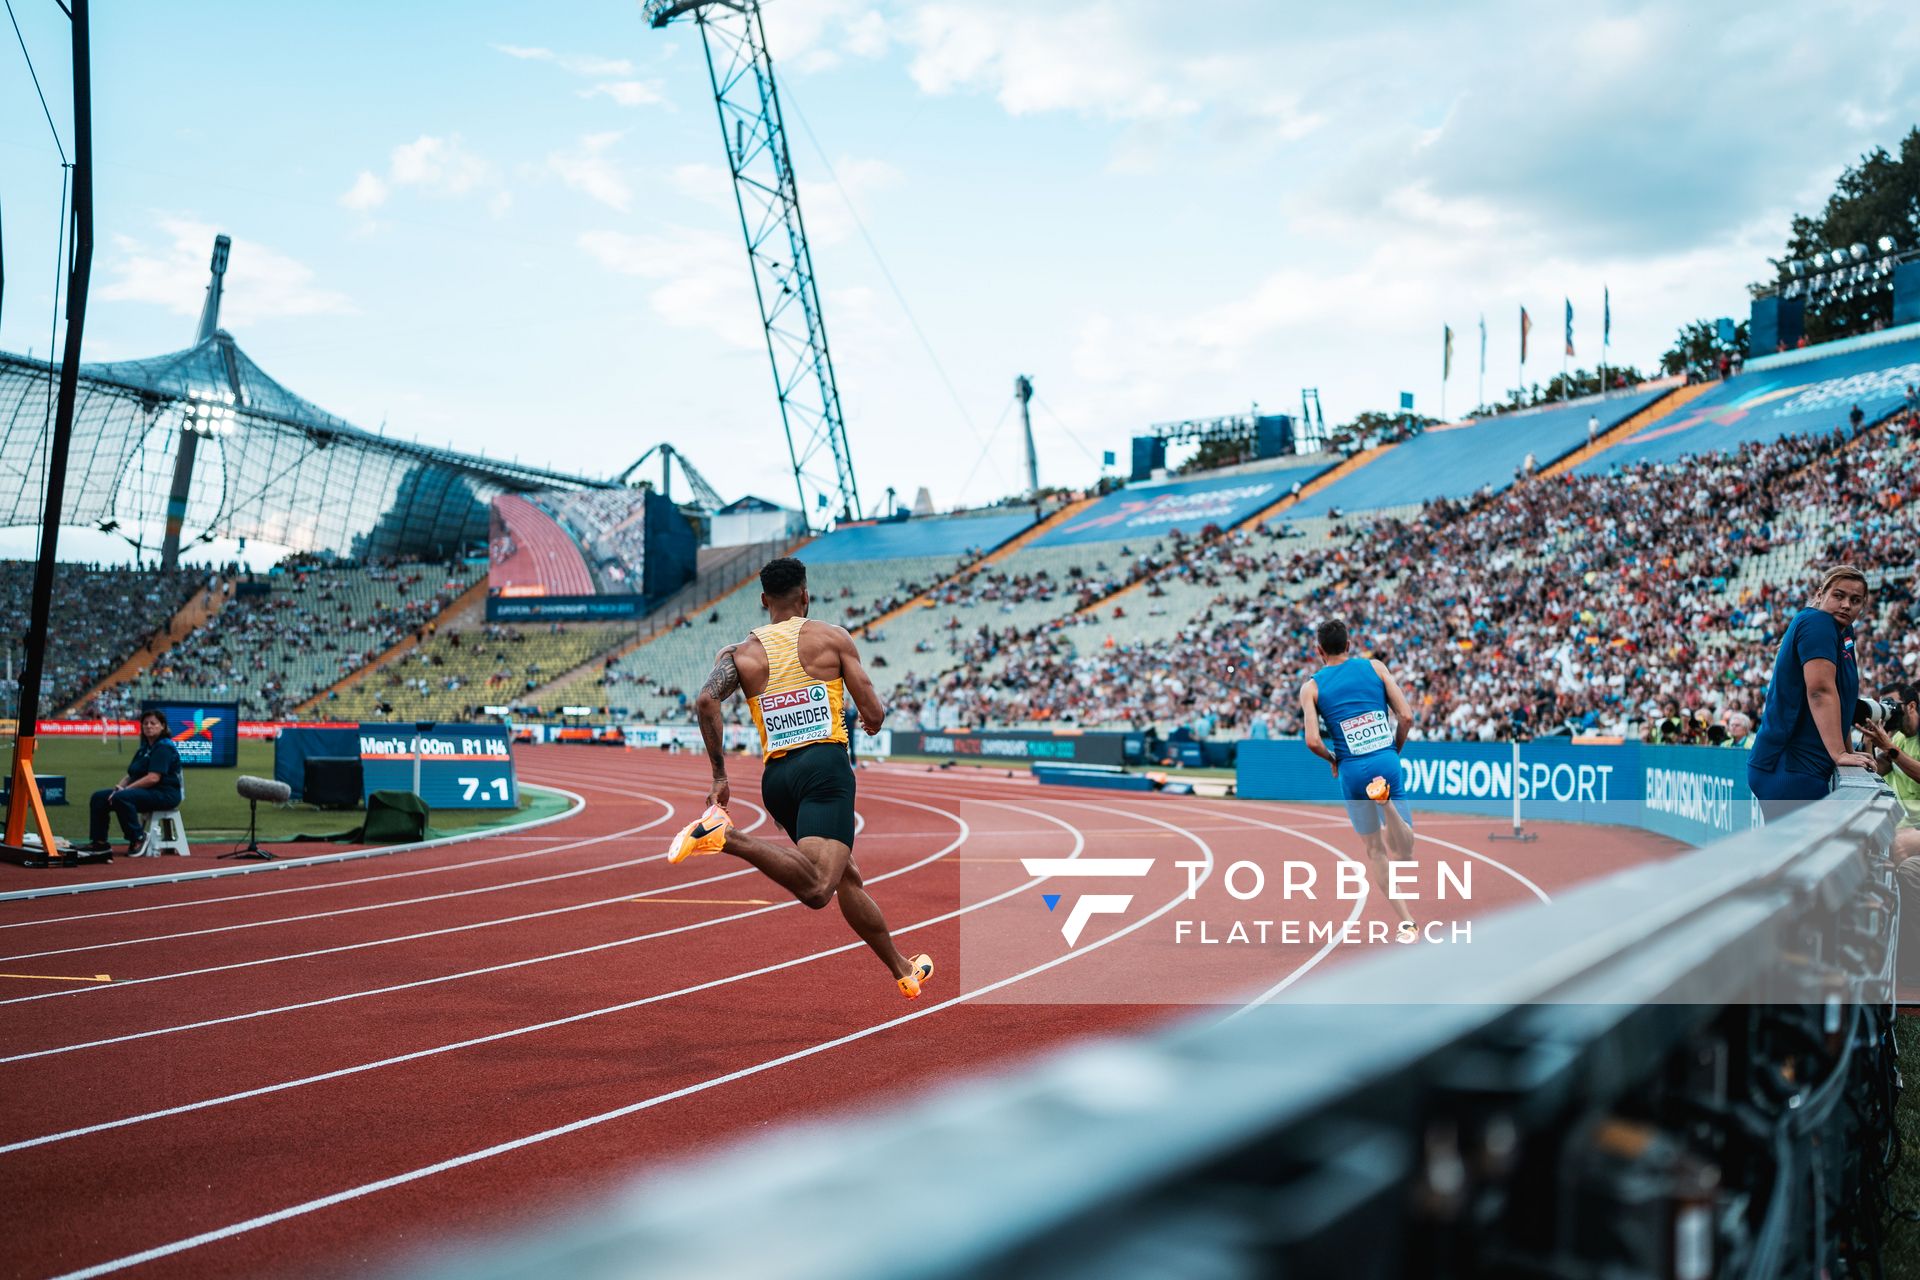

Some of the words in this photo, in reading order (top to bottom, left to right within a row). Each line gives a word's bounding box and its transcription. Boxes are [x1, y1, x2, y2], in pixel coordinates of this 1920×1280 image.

[763, 691, 809, 710] SPAR
[766, 706, 829, 732] SCHNEIDER
[1342, 714, 1374, 730] SPAR
[771, 736, 804, 748] MUNICH
[806, 729, 828, 739] 2022
[1347, 723, 1388, 743] SCOTTI
[360, 737, 406, 754] Men's
[462, 739, 482, 755] R1
[486, 739, 507, 755] H4
[458, 778, 509, 801] 7.1
